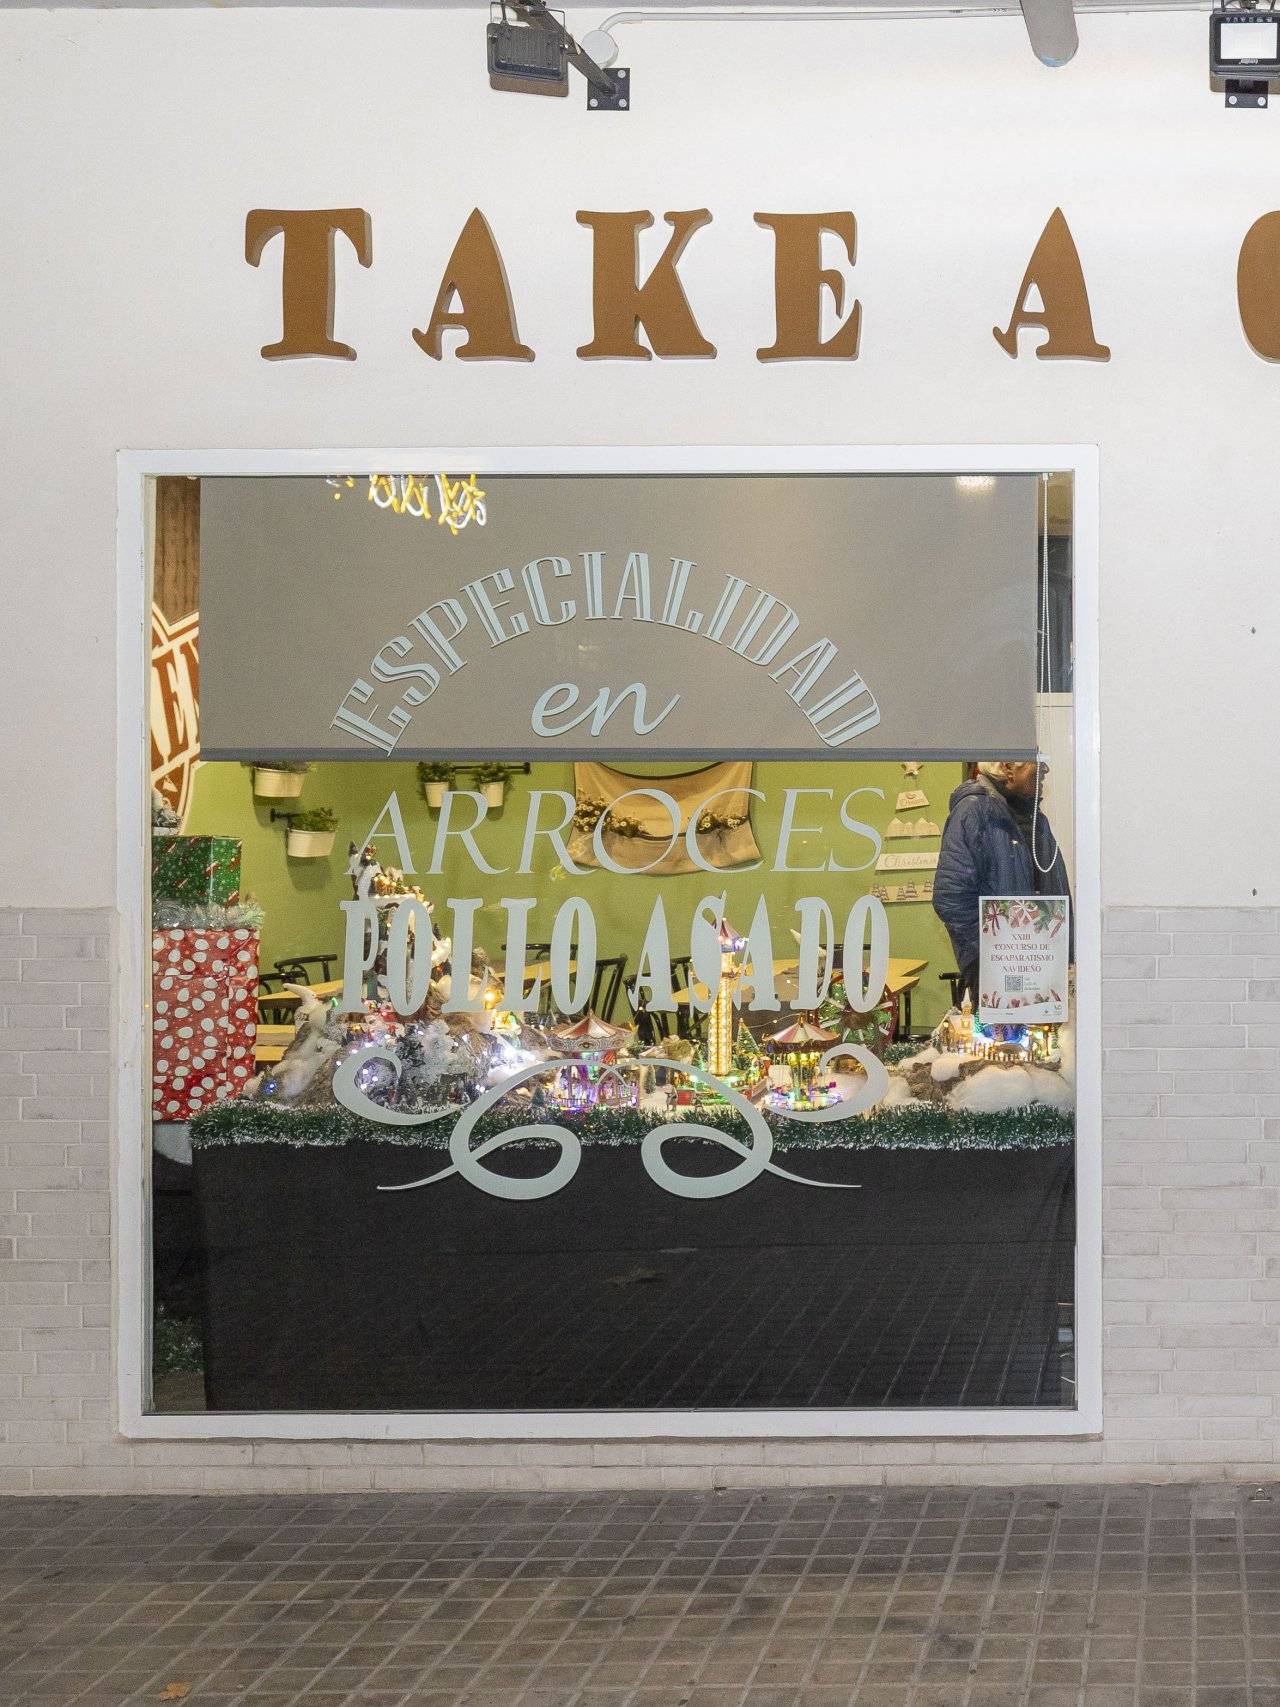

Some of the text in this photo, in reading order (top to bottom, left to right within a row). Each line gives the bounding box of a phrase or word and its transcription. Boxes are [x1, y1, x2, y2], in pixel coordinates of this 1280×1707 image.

[245, 207, 861, 363] TAKE
[993, 207, 1111, 362] A
[330, 552, 881, 757] ESPECIALIDAD
[530, 682, 681, 738] en
[343, 787, 886, 876] ARROCES
[335, 890, 891, 1017] POLLO ASADO
[1002, 965, 1042, 973] NAVIDEÑO
